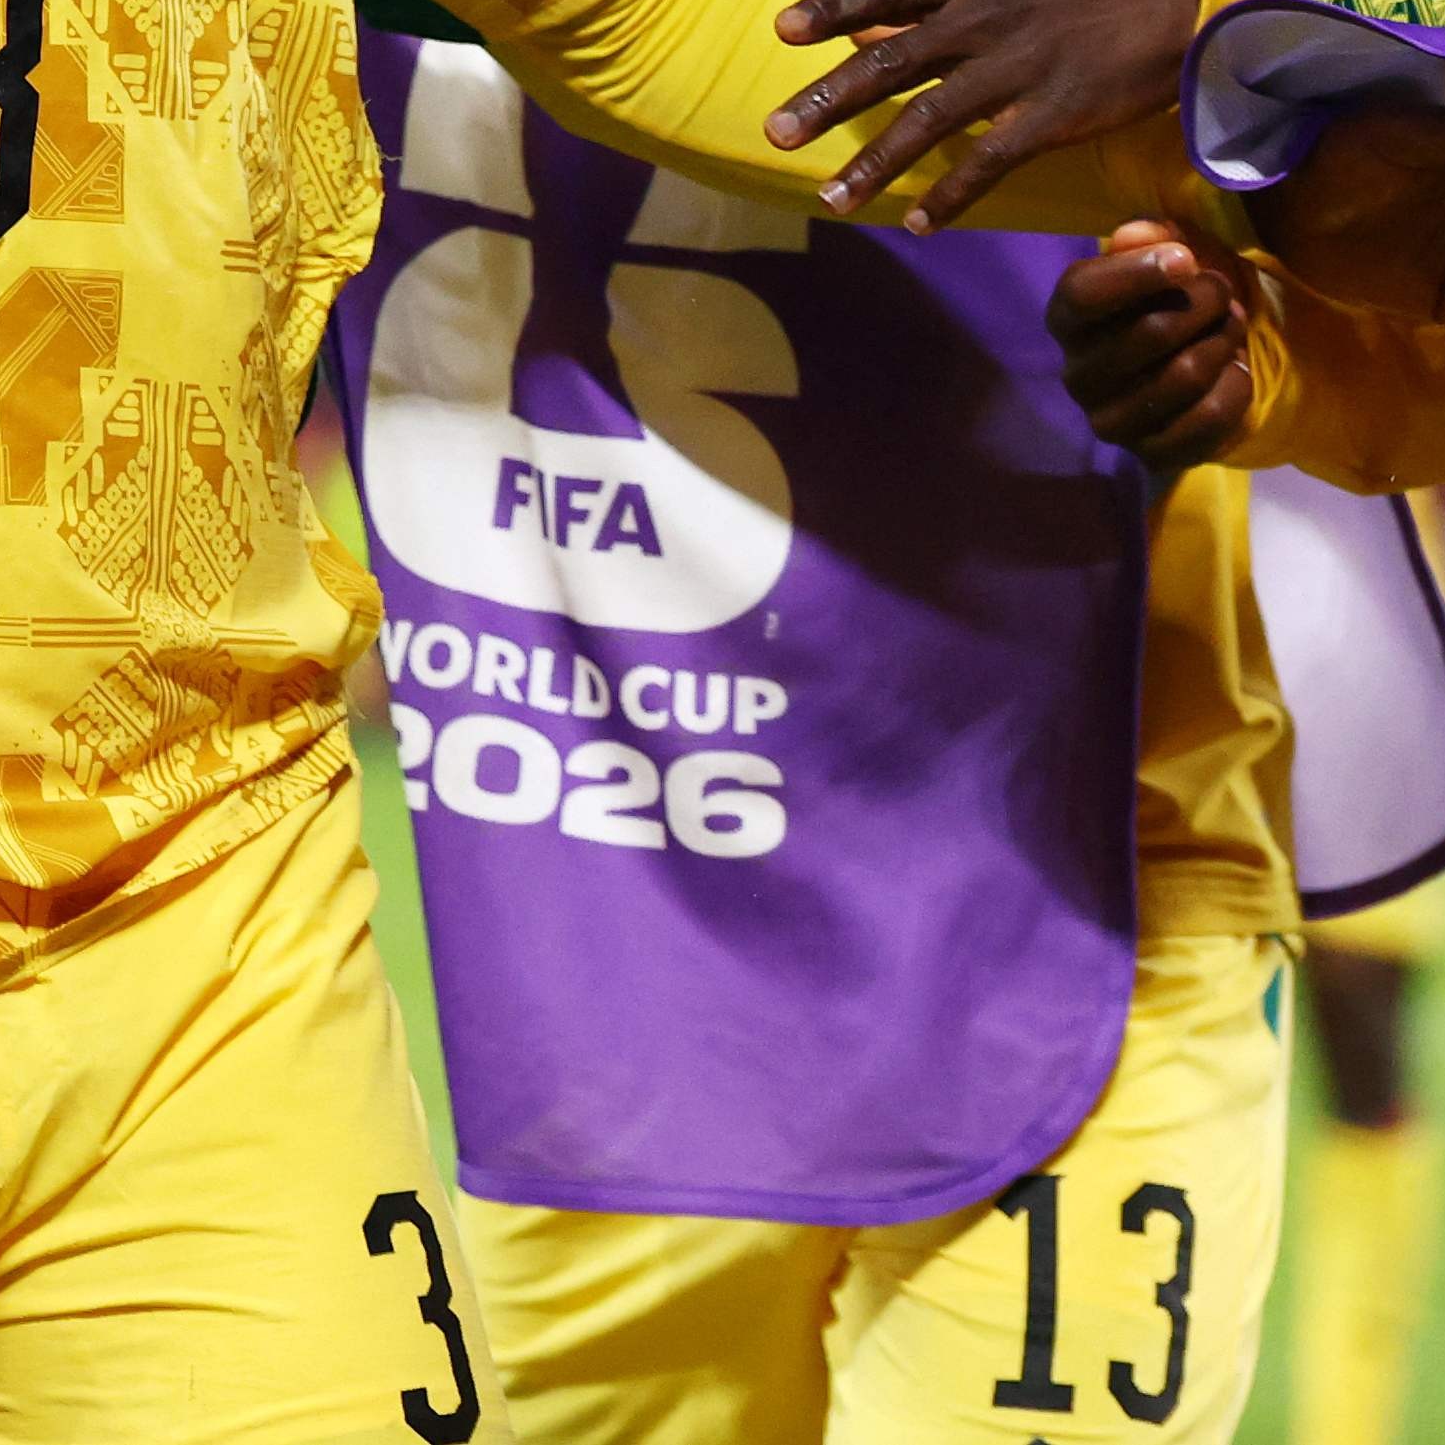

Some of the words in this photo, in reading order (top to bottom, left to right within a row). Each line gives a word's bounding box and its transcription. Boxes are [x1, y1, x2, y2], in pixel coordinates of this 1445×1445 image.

[492, 457, 664, 558] FIFA
[619, 664, 788, 735] CUP
[362, 1190, 481, 1445] 3
[992, 1174, 1195, 1426] 13
